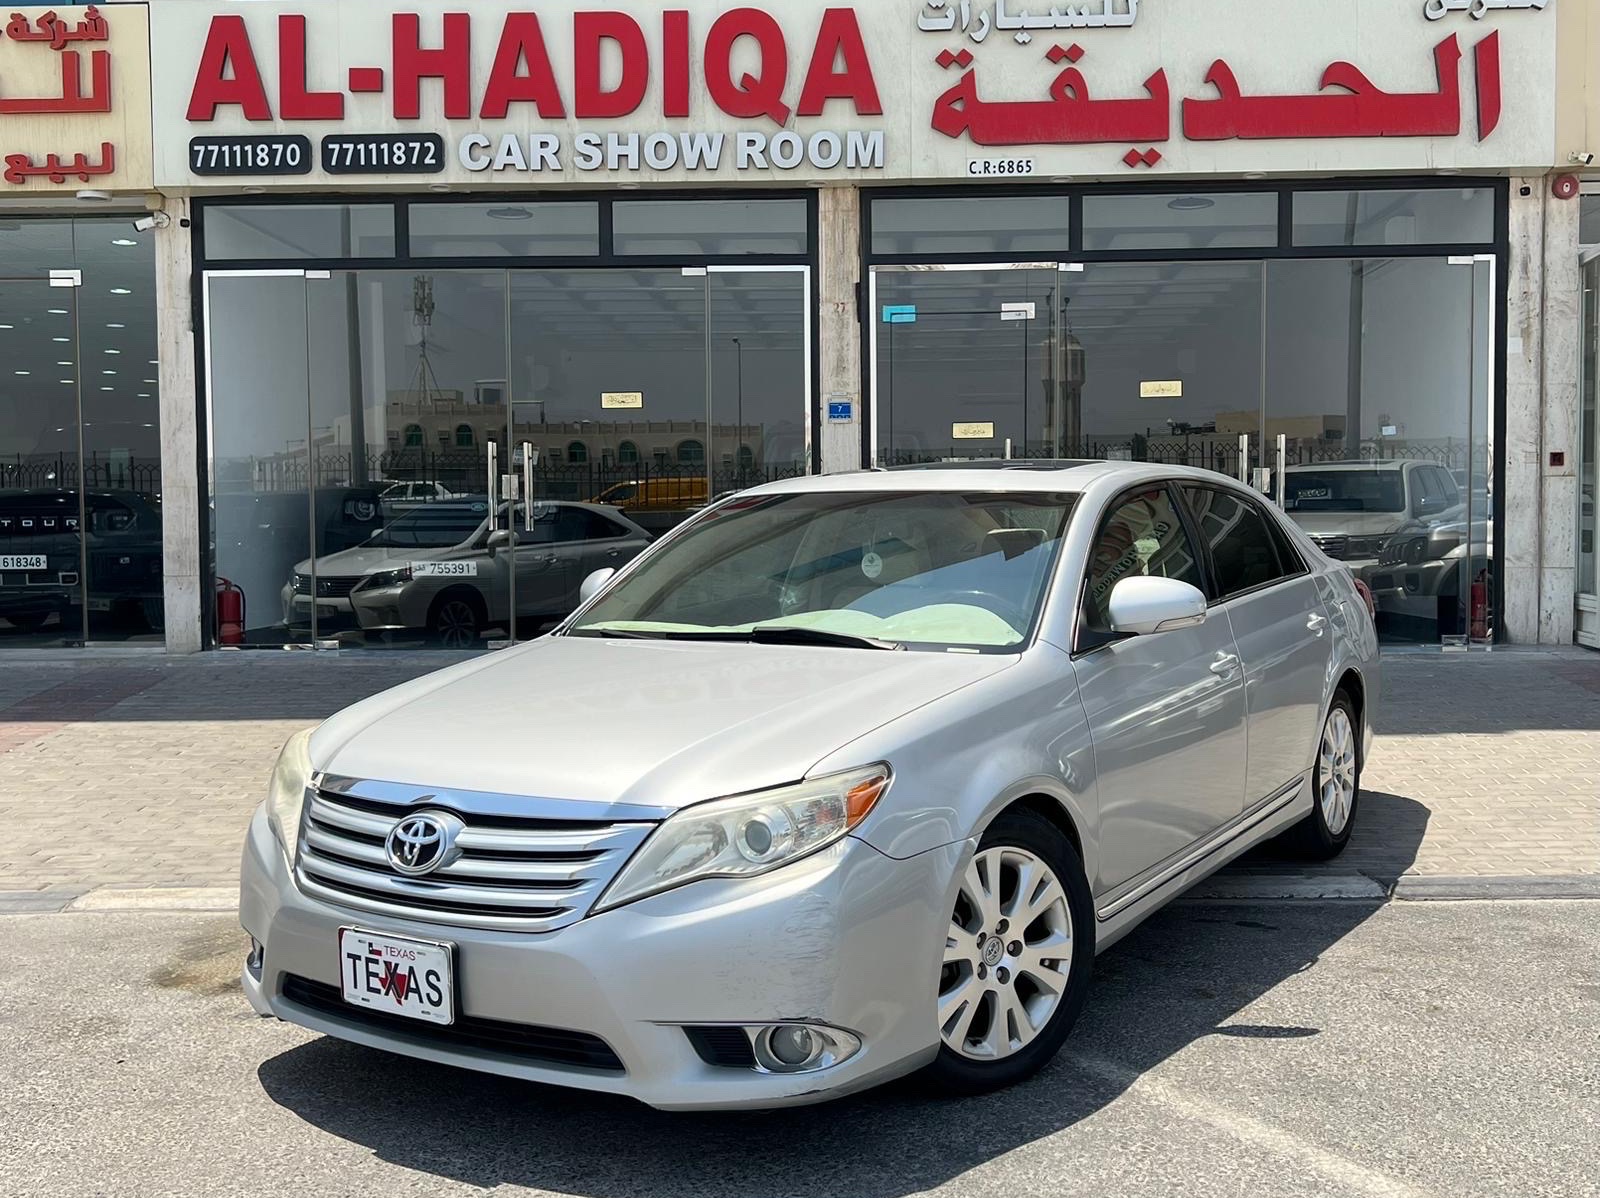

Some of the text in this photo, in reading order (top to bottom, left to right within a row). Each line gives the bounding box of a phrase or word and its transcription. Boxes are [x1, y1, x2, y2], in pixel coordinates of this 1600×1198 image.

[6, 5, 109, 50] شركة
[186, 7, 883, 127] AL-HADIQA
[931, 29, 1502, 168] الحديقة
[4, 142, 115, 184] لبيع
[193, 144, 300, 167] 77111870
[328, 142, 436, 166] 77111872
[458, 131, 885, 172] CAR SHOW ROOM
[968, 159, 1033, 175] C.R:6865
[2, 556, 43, 568] 618348
[430, 563, 470, 574] 755391
[384, 945, 416, 961] TEXAS
[346, 952, 443, 1008] TEXAS
